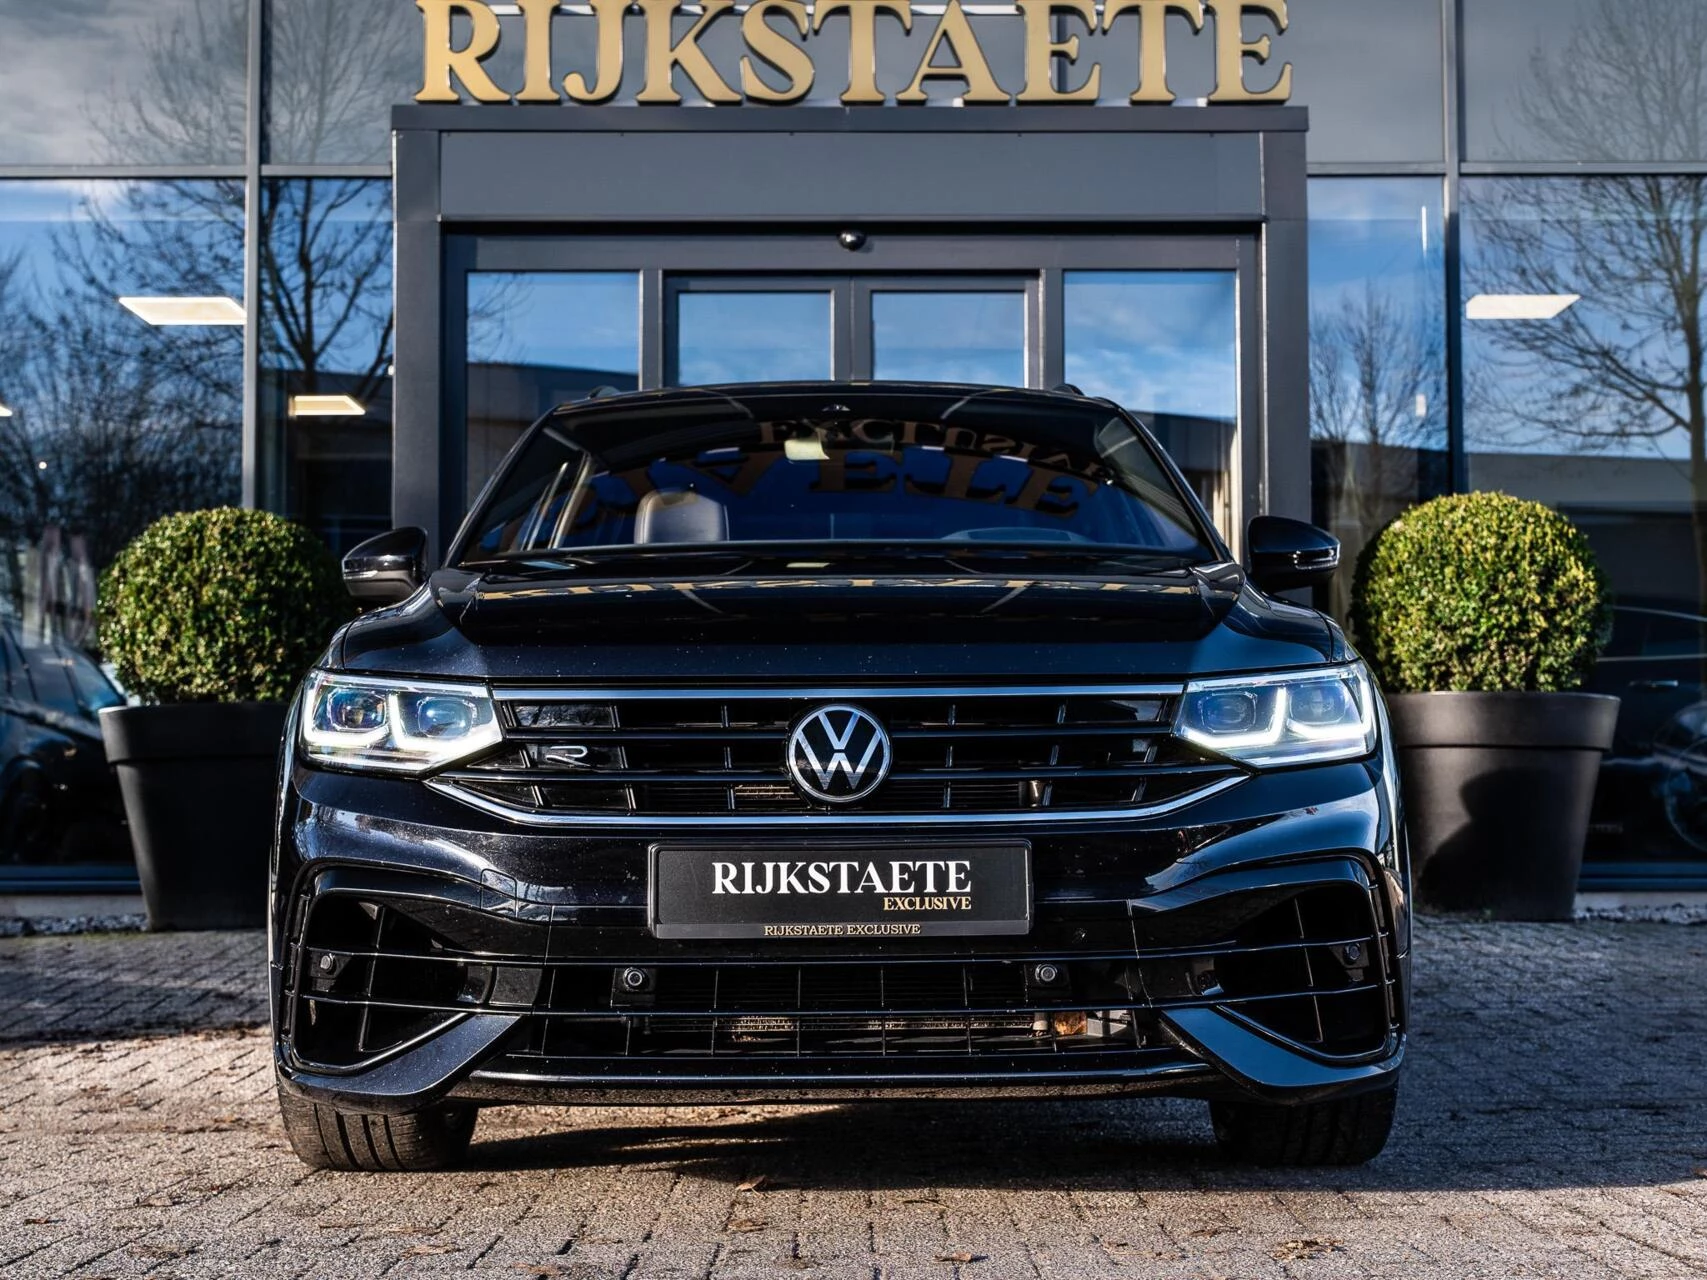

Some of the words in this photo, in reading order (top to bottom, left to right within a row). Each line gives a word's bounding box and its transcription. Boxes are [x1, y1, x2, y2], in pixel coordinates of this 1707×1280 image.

[414, 0, 1295, 106] RIJKSTAETE
[711, 860, 972, 895] RIJKSTAETE
[882, 896, 972, 911] EXCLUSIVE
[763, 924, 844, 936] RIJKSTAETE
[846, 923, 922, 935] EXCLUSIVE
